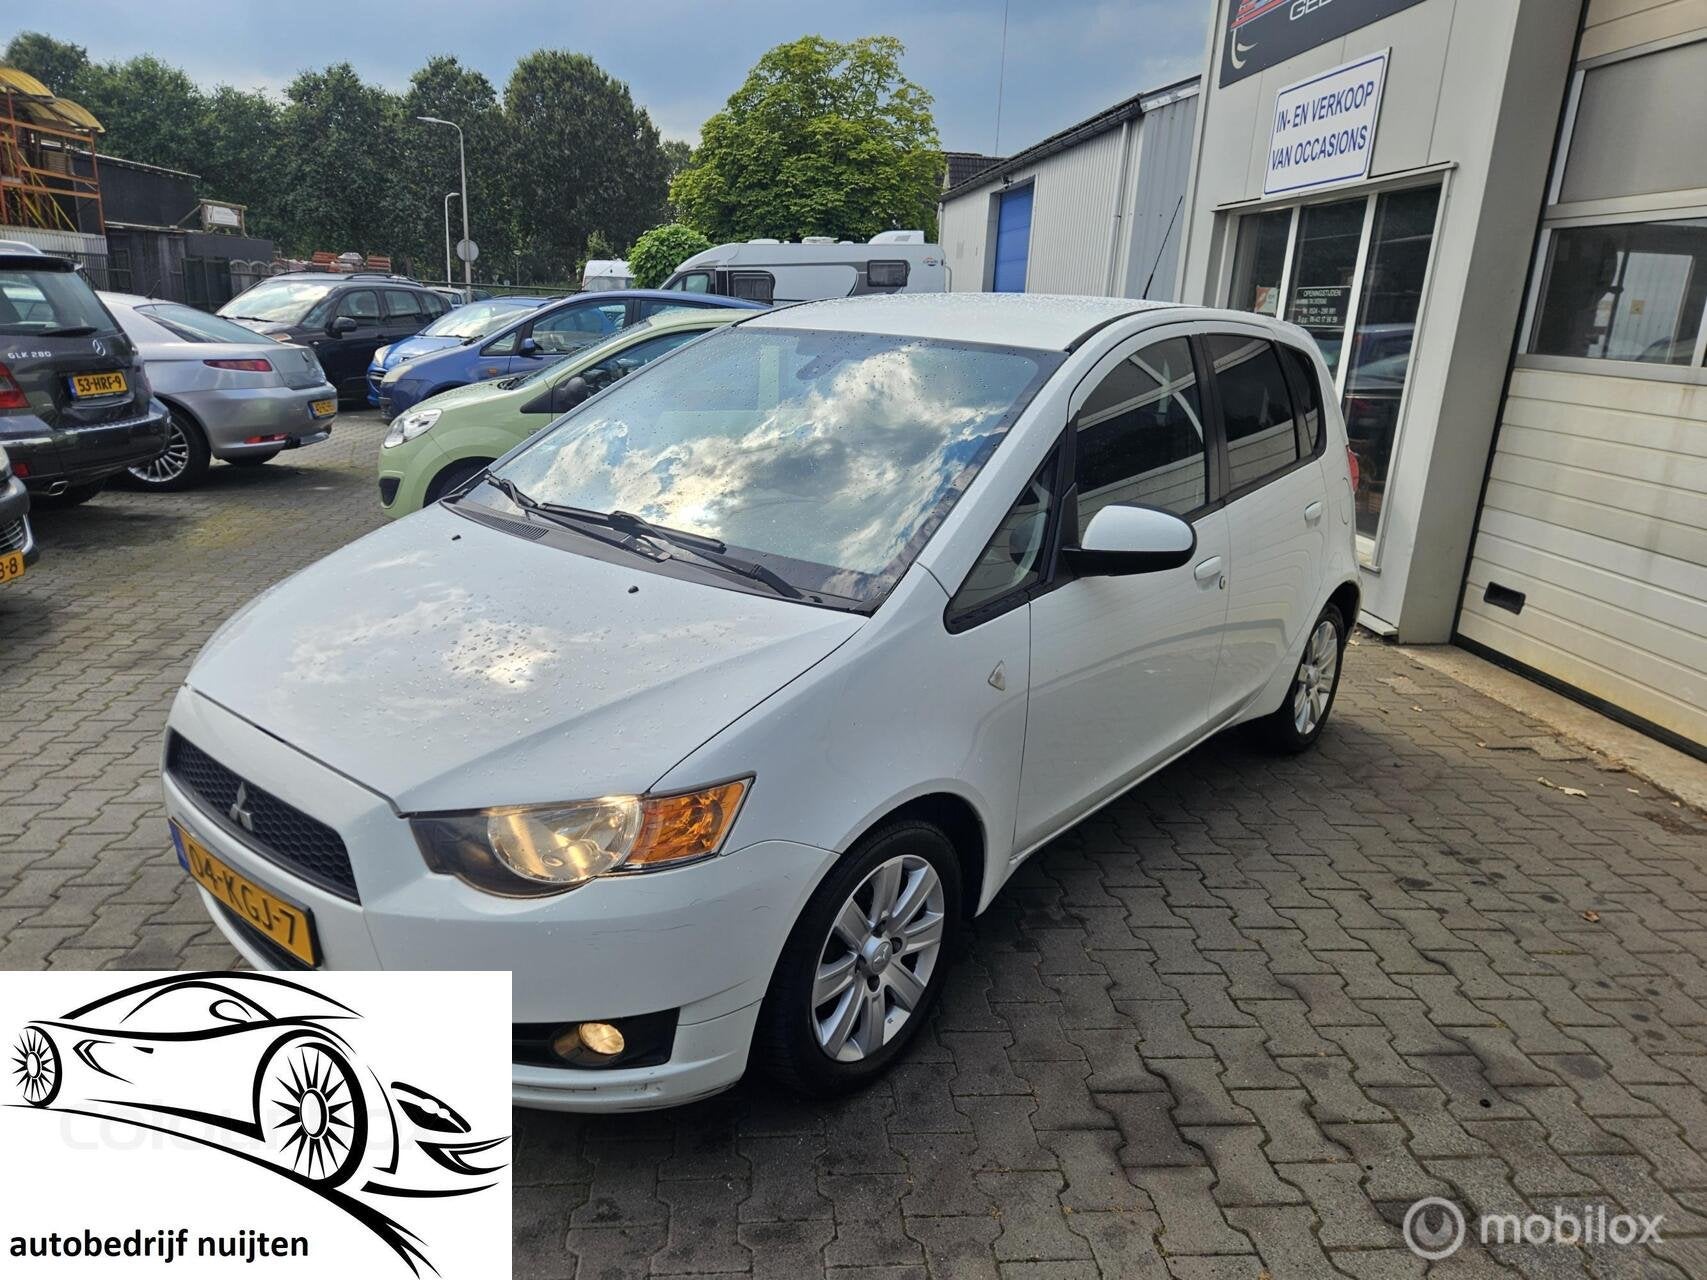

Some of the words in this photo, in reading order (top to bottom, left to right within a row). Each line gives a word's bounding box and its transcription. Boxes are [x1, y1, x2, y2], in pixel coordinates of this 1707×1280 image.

[1311, 81, 1374, 120] VERKOOP
[1271, 145, 1292, 170] VAN
[1293, 125, 1367, 165] OCCASIONS
[7, 351, 28, 359] GLK
[31, 350, 52, 358] 280
[77, 375, 122, 393] 53-HRF-9
